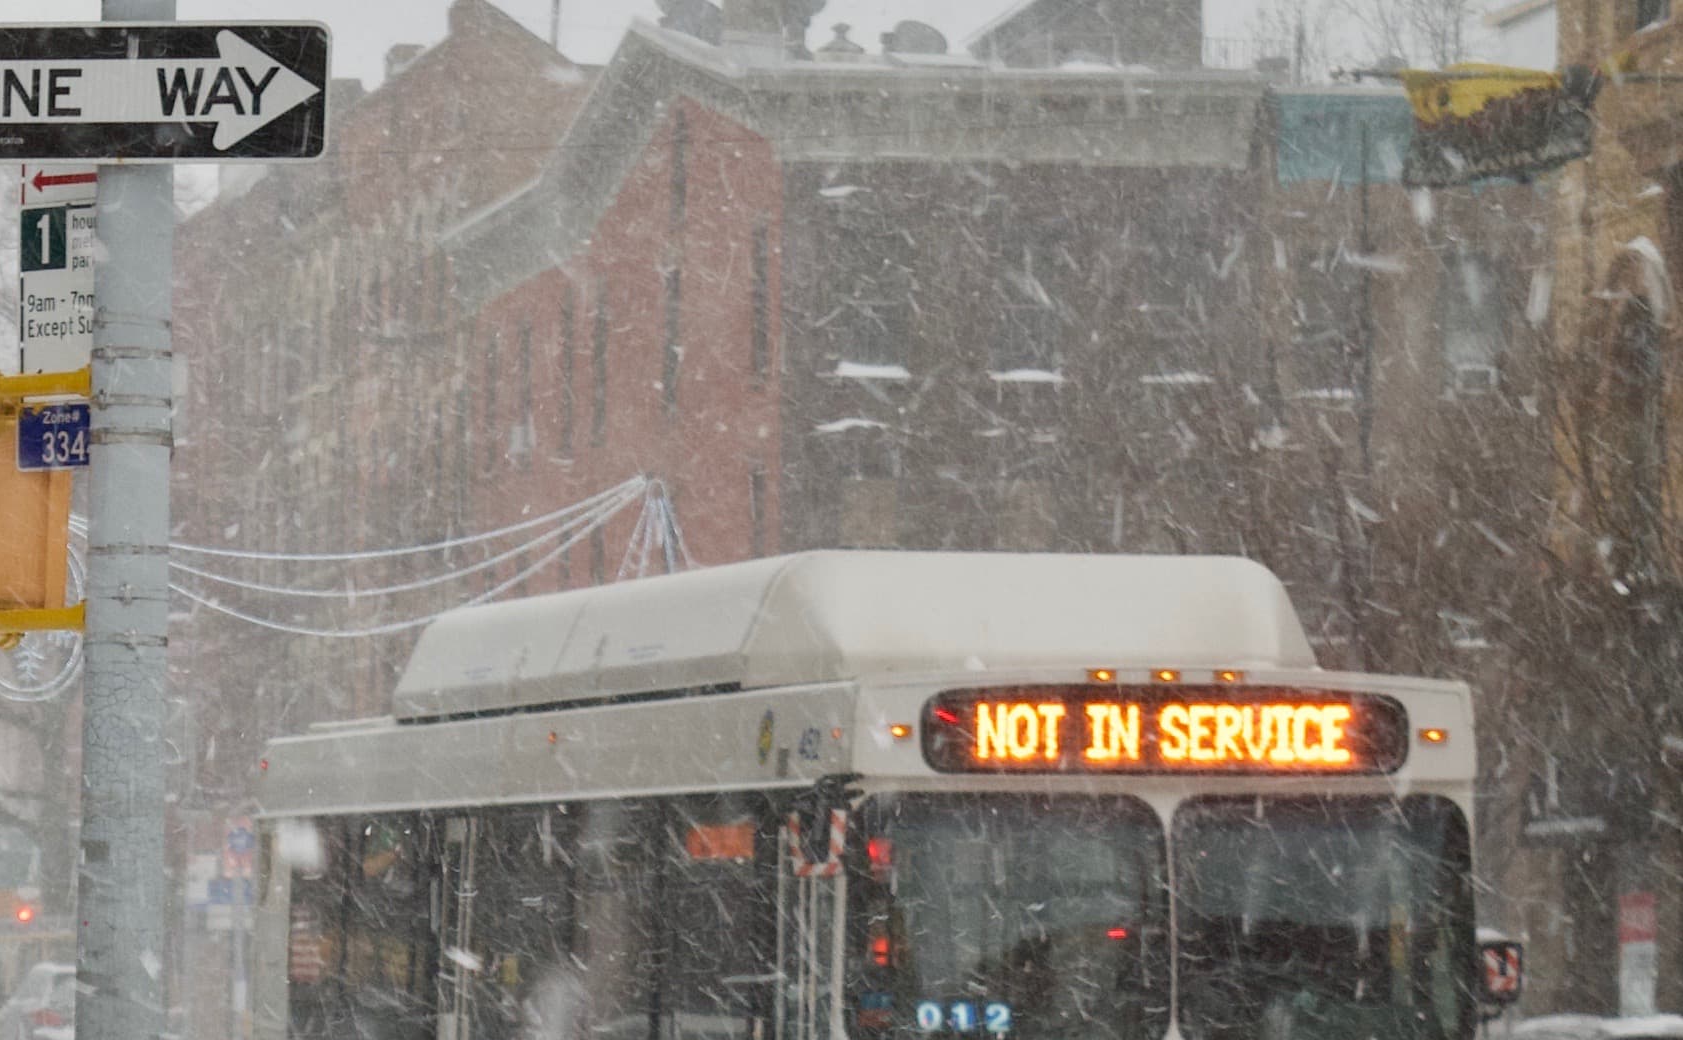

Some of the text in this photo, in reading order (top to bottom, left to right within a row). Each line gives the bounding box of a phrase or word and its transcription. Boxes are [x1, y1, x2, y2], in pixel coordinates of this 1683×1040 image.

[156, 66, 281, 116] WAY
[36, 213, 51, 265] 1
[27, 294, 56, 313] 9am
[27, 315, 94, 340] Except Su
[41, 430, 92, 464] 334
[975, 702, 1352, 763] NOT IN SERVICE
